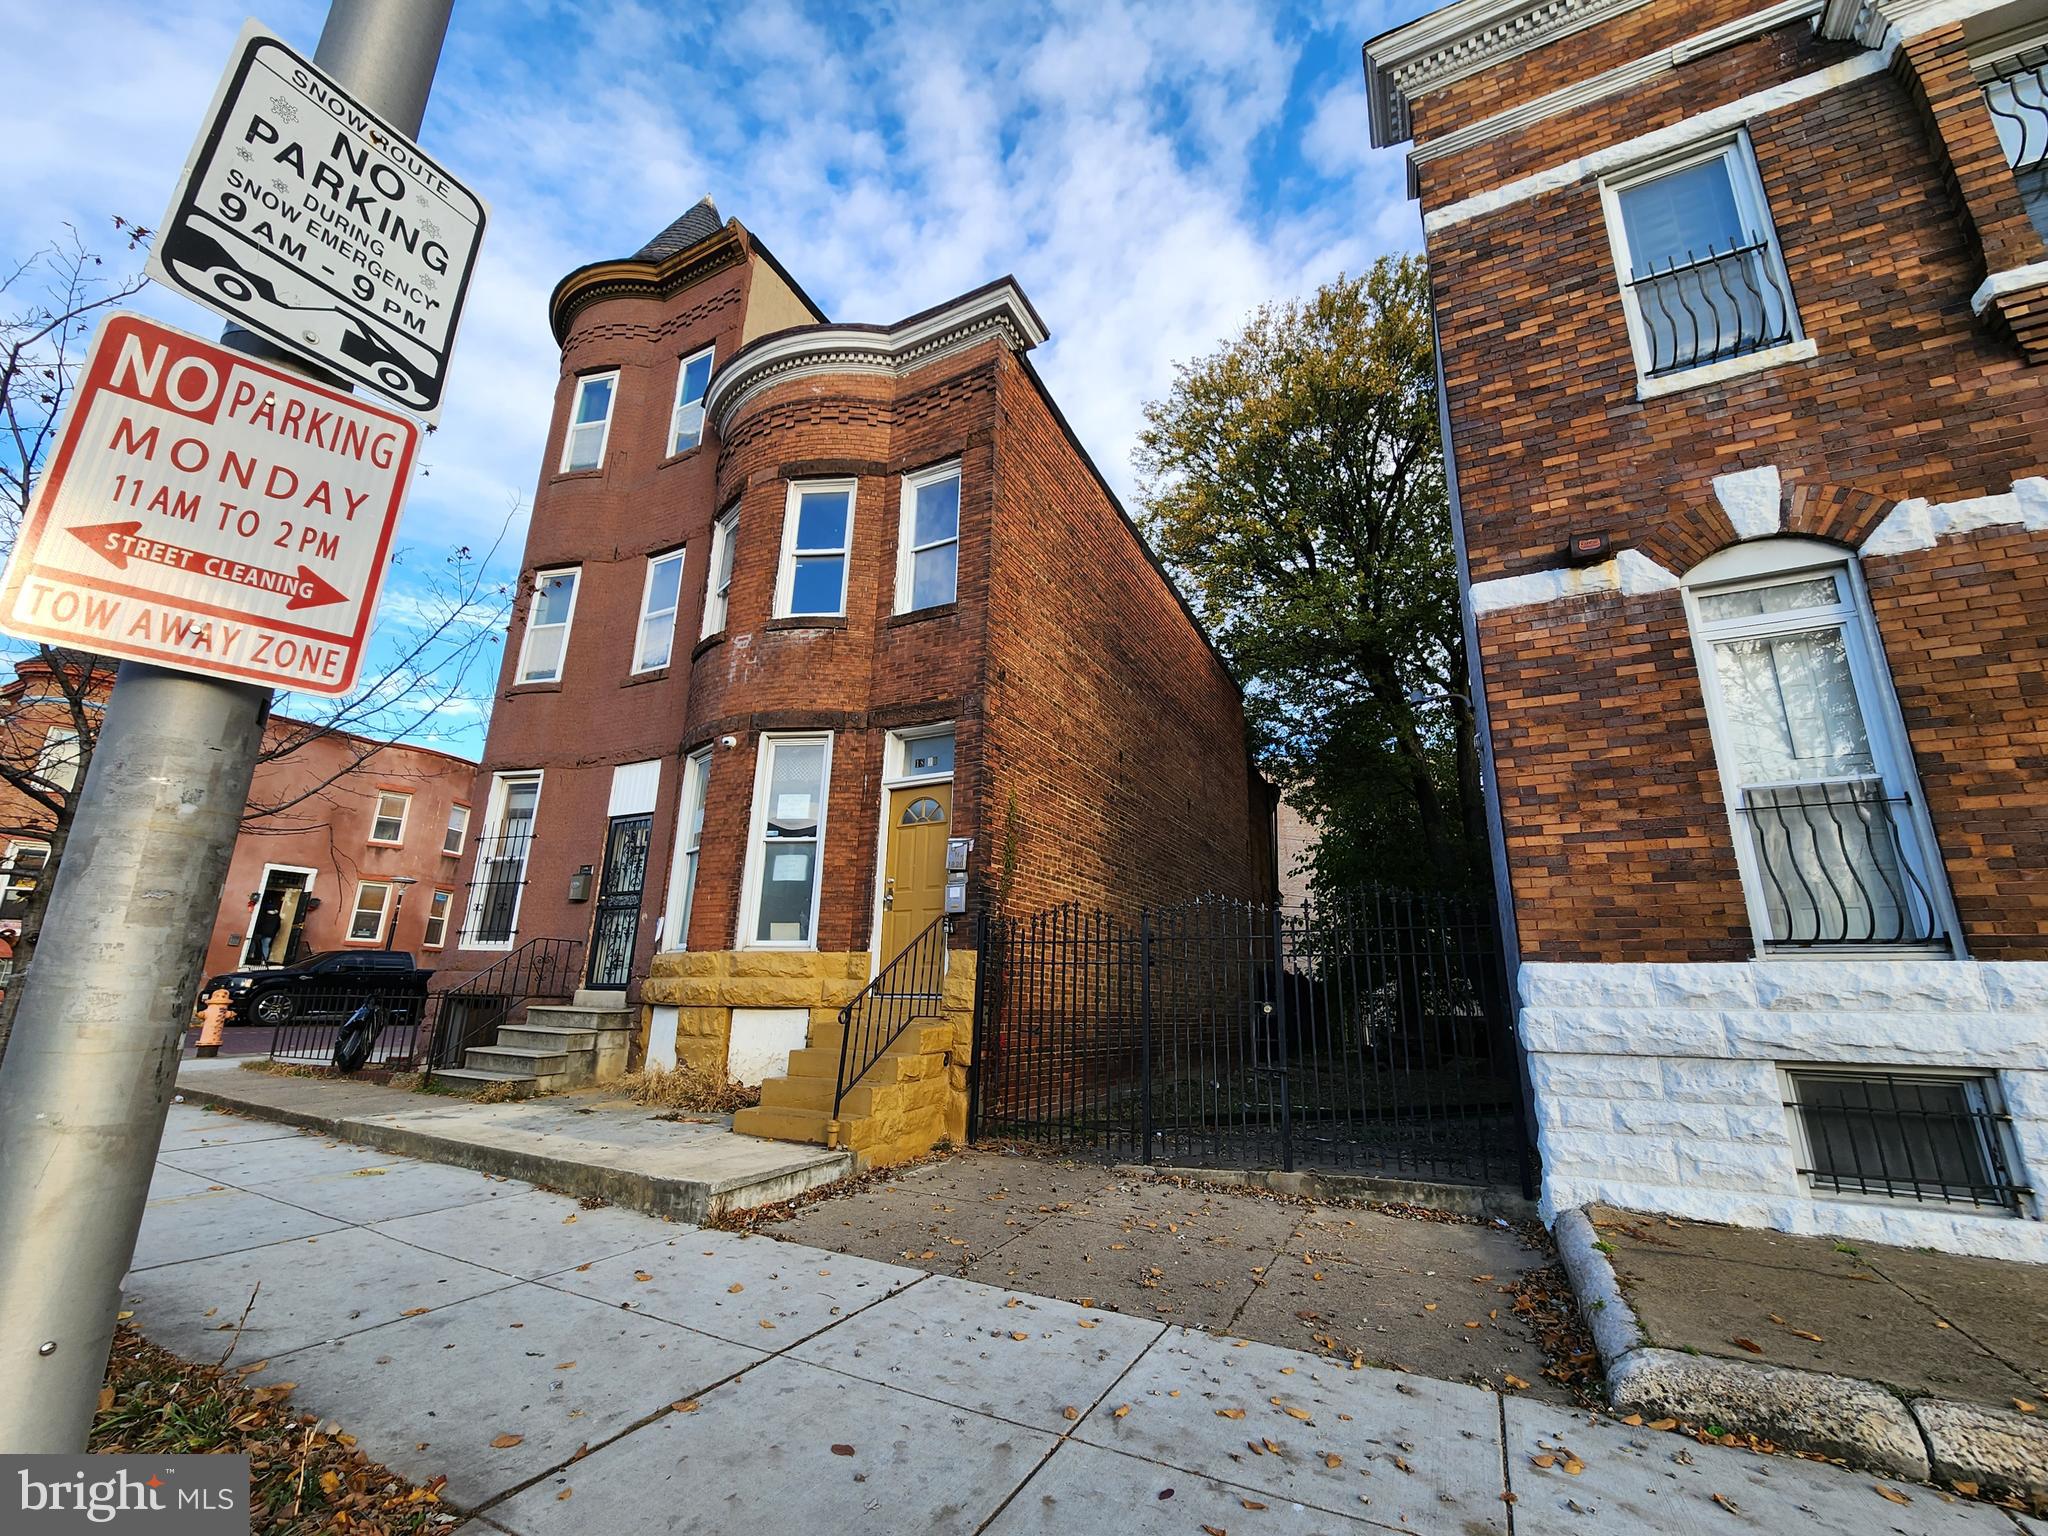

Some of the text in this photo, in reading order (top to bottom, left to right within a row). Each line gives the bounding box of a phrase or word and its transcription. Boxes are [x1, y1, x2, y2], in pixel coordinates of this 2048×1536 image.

[292, 69, 450, 199] SNOW ROUTE
[330, 131, 406, 201] NO
[226, 168, 438, 311] SNOW EMERGENCY
[244, 114, 450, 276] PARKING
[302, 193, 385, 258] DURING
[218, 192, 247, 222] 9
[251, 221, 308, 263] AM
[351, 274, 375, 302] 9
[382, 299, 426, 335] PM
[109, 333, 397, 470] NO PARKING
[109, 417, 369, 522] MONDAY
[112, 474, 341, 561] 11 AM TO 2 PM
[105, 533, 314, 599] STREET CLEANING
[32, 583, 341, 678] TOW AWAY ZONE
